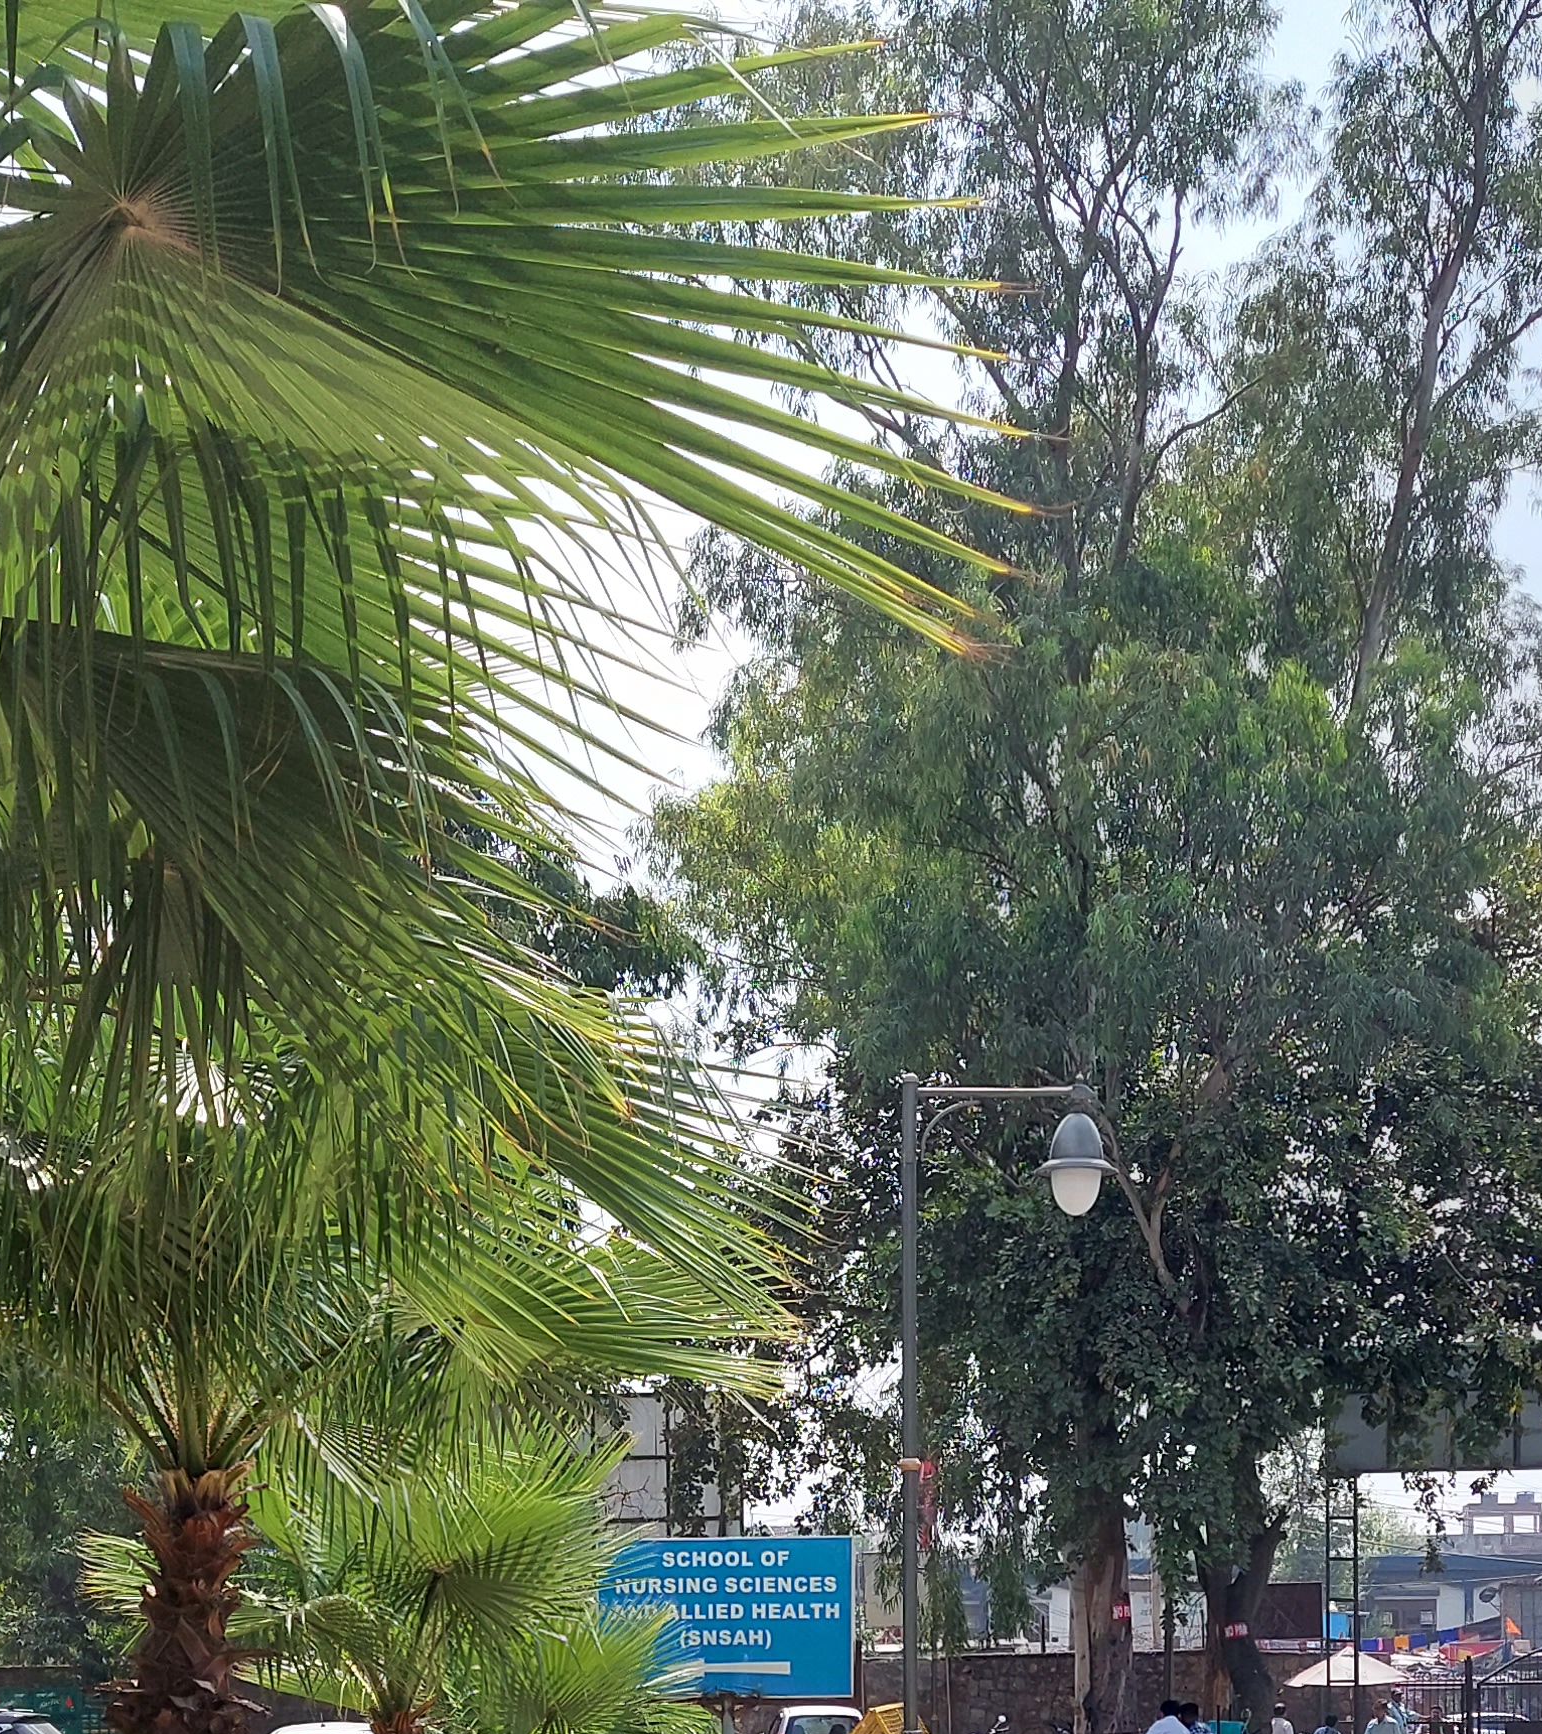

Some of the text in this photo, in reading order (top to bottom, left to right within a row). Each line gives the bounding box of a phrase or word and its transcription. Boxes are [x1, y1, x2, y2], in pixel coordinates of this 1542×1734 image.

[662, 1550, 789, 1567] SCHOOL OF
[615, 1576, 837, 1594] NURSING SCIENCES
[752, 1602, 840, 1619] HEALTH
[680, 1629, 772, 1649] (SNSAH)
